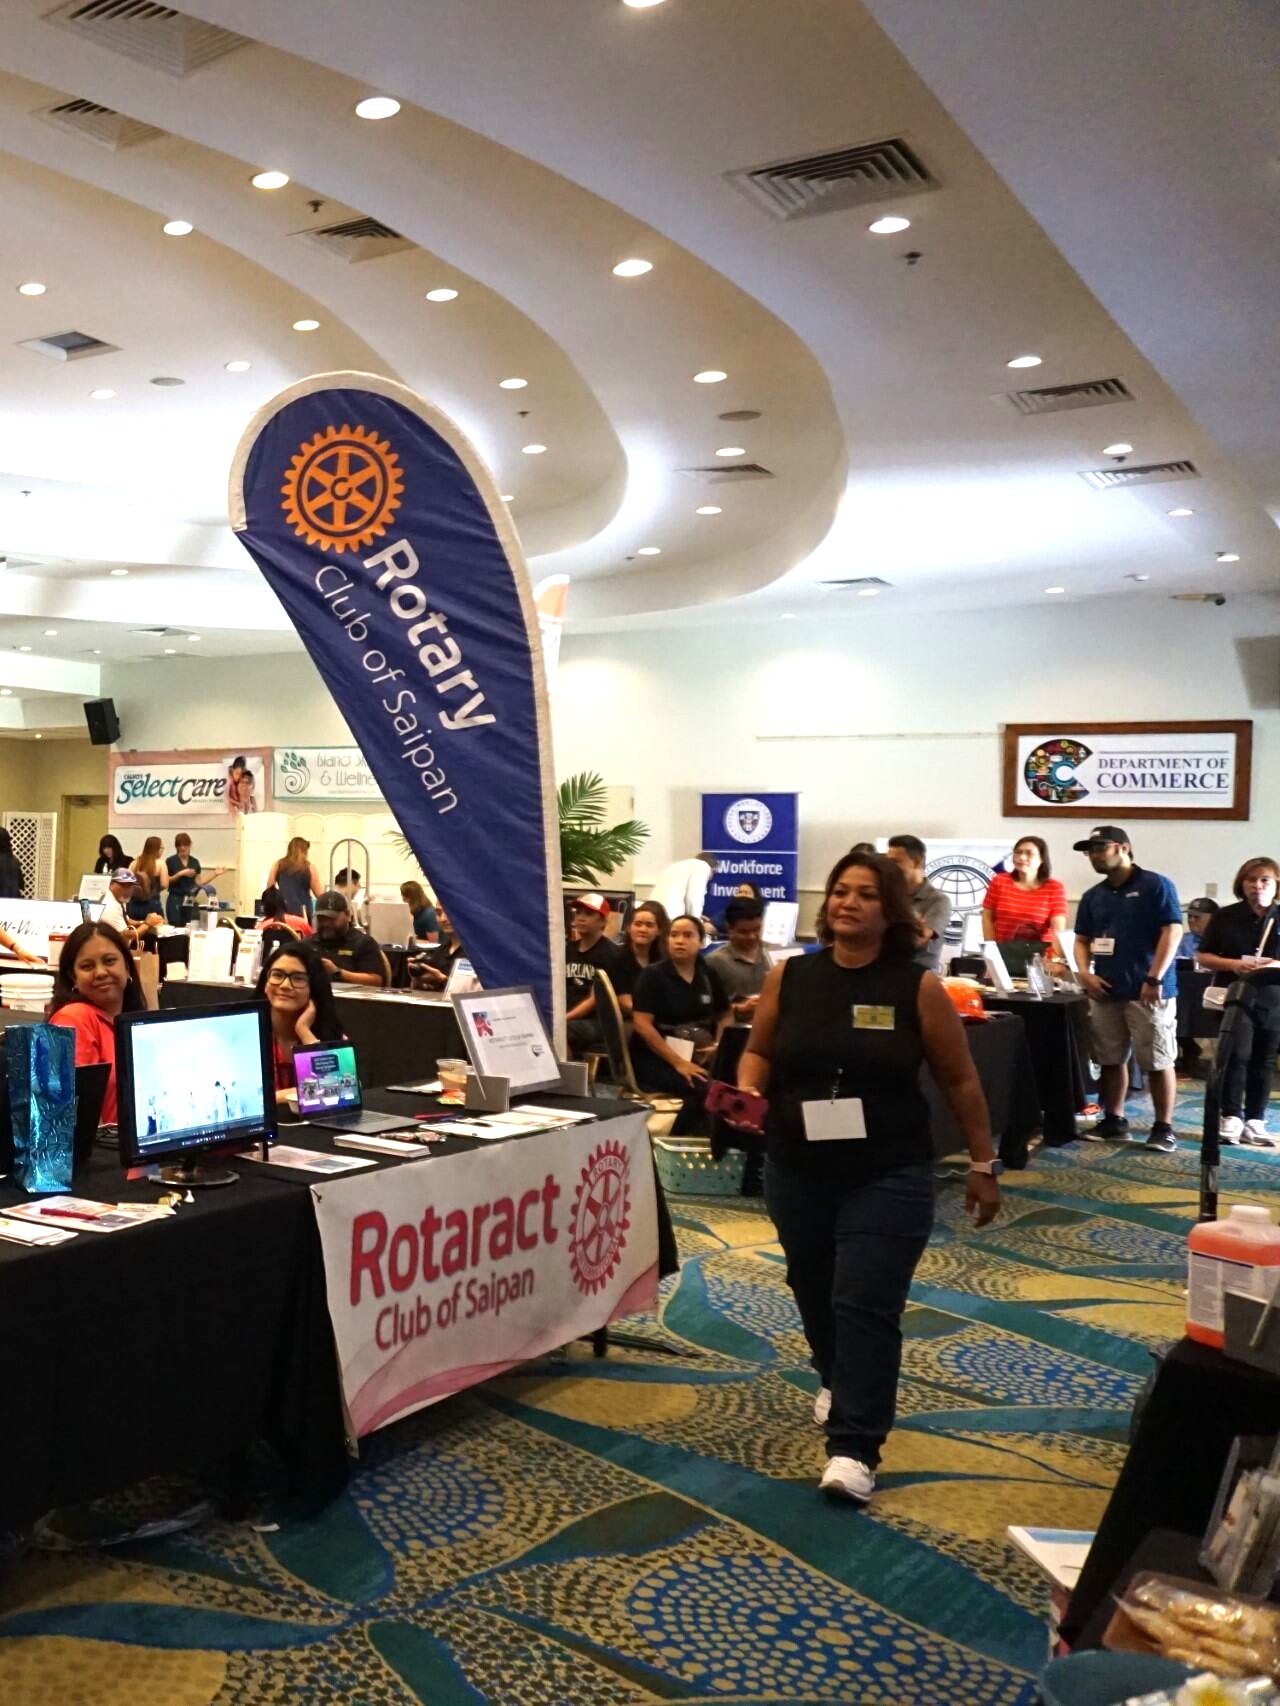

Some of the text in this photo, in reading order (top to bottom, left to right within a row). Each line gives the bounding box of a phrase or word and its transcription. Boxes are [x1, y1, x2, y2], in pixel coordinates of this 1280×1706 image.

[362, 538, 496, 731] Rotary
[314, 565, 458, 814] Club of Saipan
[1098, 758, 1230, 769] DEPARTMENT OF
[335, 769, 377, 787] Wellne
[1097, 772, 1230, 789] COMMERCE
[716, 860, 783, 875] Workforce
[713, 882, 786, 899] Inveent
[349, 1173, 561, 1308] Rotaract
[375, 1268, 535, 1351] Club of Saipan
